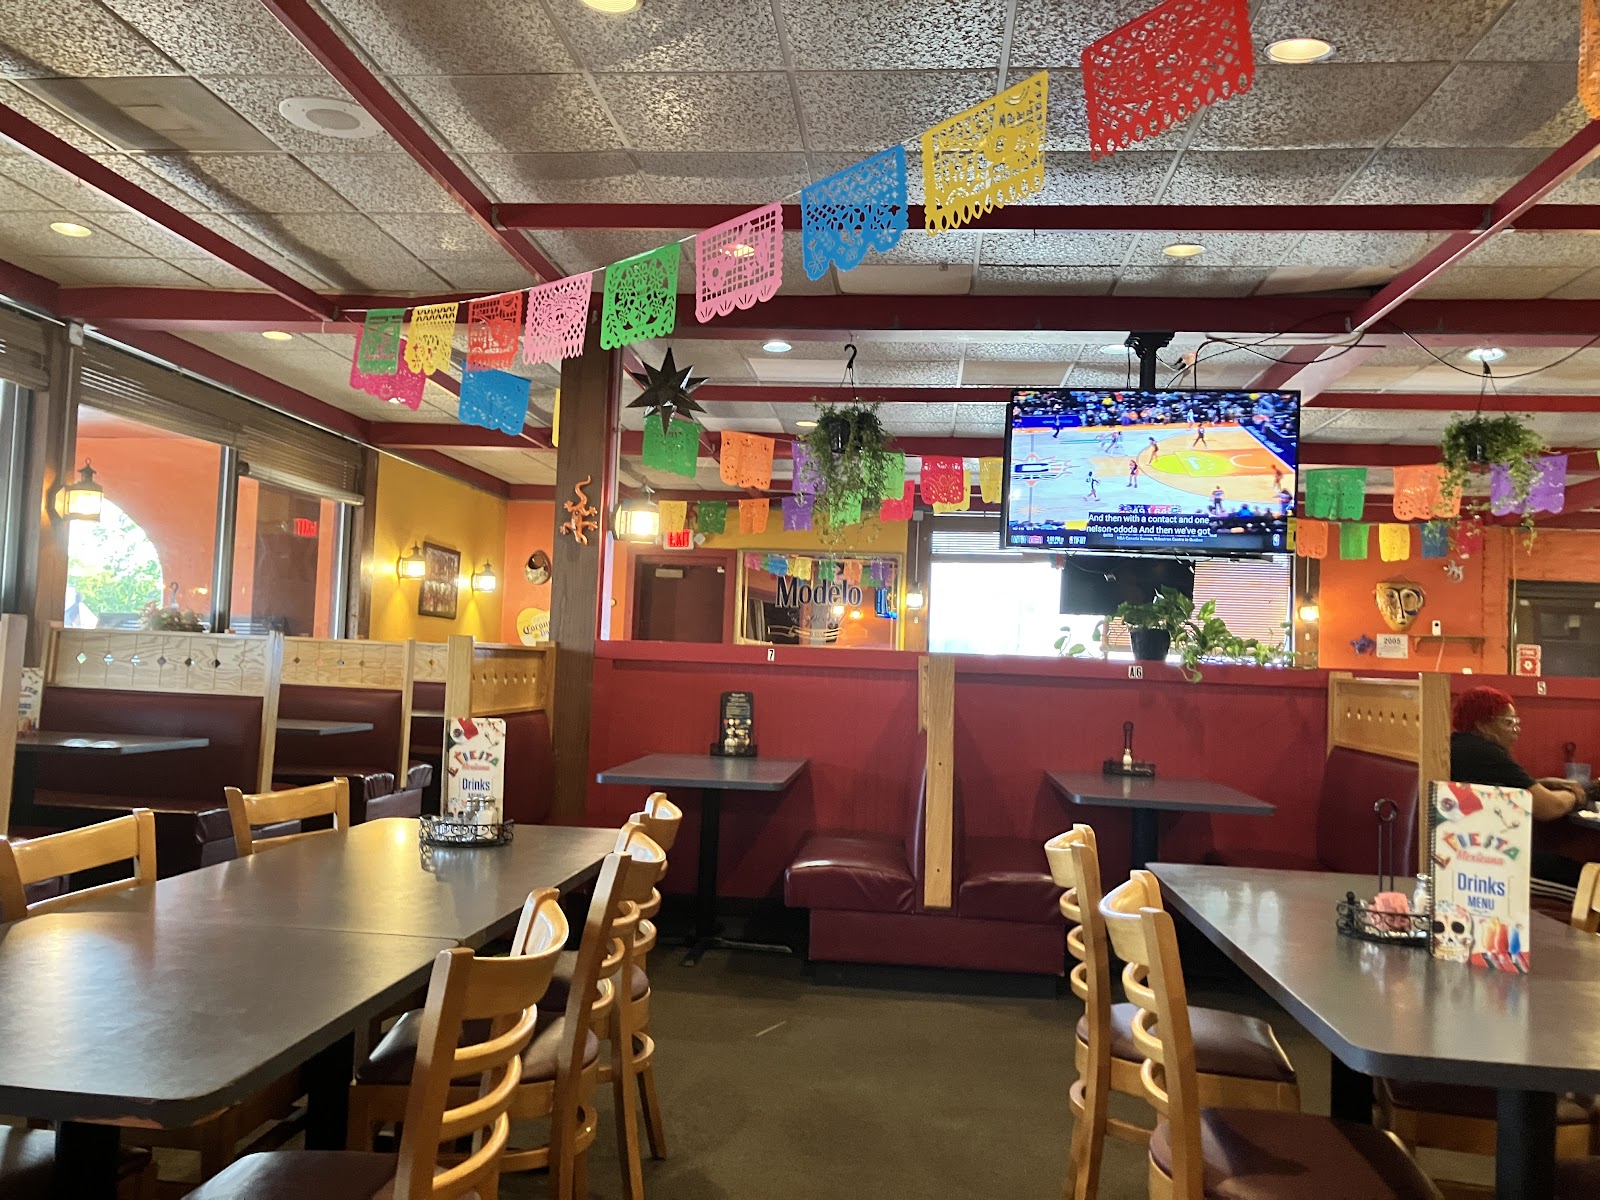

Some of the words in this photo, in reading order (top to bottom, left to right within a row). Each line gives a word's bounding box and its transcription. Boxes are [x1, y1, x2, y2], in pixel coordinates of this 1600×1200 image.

[1088, 514, 1104, 522] And
[1105, 514, 1122, 522] then
[1123, 514, 1140, 523] with
[1148, 515, 1177, 524] contact
[1179, 515, 1193, 524] and
[668, 530, 690, 547] EXIT
[1086, 525, 1138, 534] nelson-ododa
[1139, 526, 1153, 534] And
[1156, 526, 1173, 534] then
[1174, 526, 1196, 535] we've
[1197, 527, 1211, 536] got
[775, 576, 863, 608] Modelo
[523, 621, 550, 635] Coron
[769, 649, 774, 660] 7
[454, 750, 499, 767] FIESTA
[462, 778, 491, 791] Drinks
[1443, 832, 1520, 861] FIESTA
[1456, 849, 1505, 866] Mexicana
[1457, 872, 1505, 897] Drinks
[1467, 895, 1495, 910] MENU
